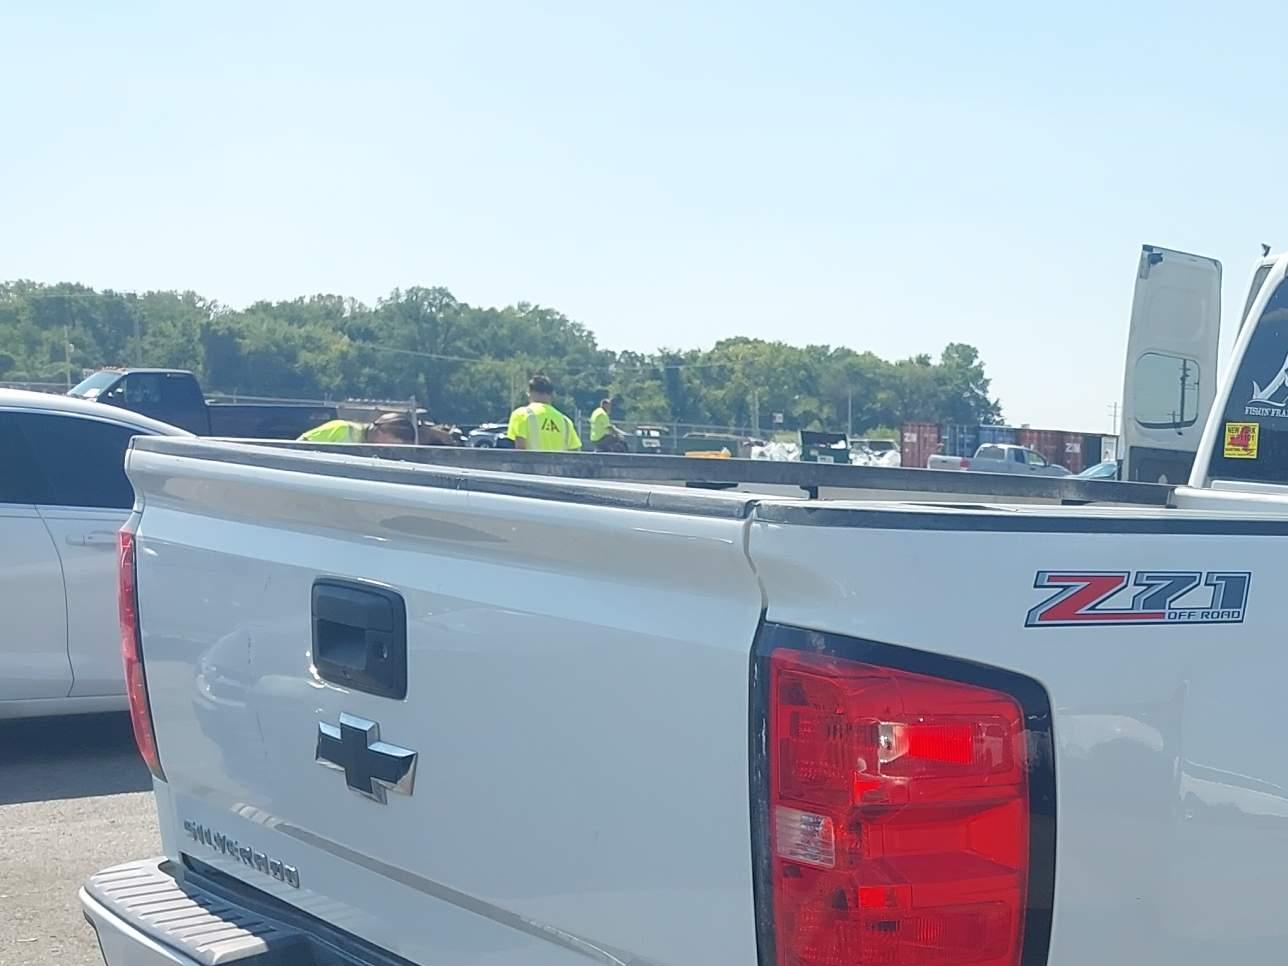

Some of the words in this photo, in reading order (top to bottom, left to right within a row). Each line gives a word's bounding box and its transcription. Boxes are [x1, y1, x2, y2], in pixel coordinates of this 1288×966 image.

[1024, 570, 1252, 628] Z71
[1167, 611, 1197, 620] OFF
[1200, 610, 1241, 620] ROAD
